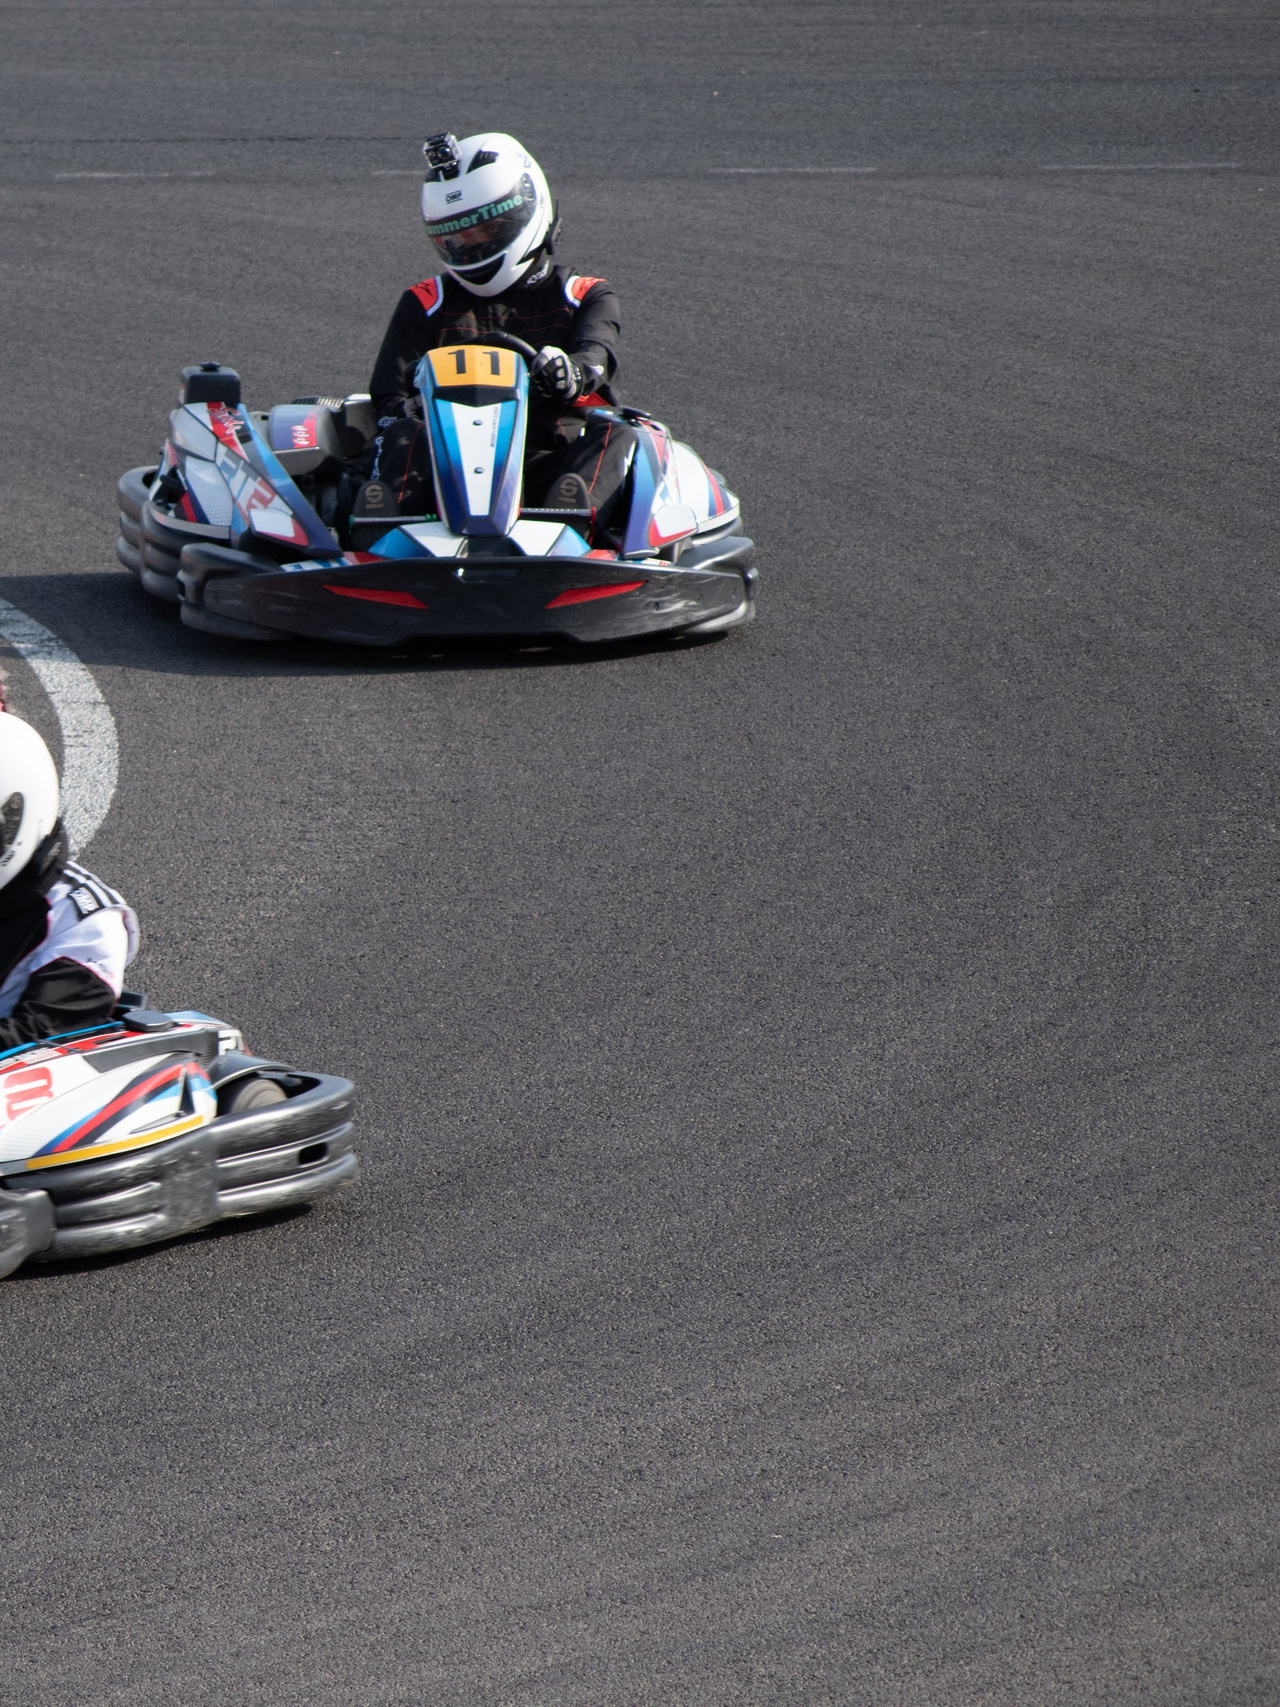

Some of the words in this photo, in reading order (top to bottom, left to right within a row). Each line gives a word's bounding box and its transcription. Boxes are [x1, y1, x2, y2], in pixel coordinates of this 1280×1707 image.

[445, 191, 463, 203] OMP
[426, 194, 524, 235] ammerTime
[447, 348, 501, 376] 11
